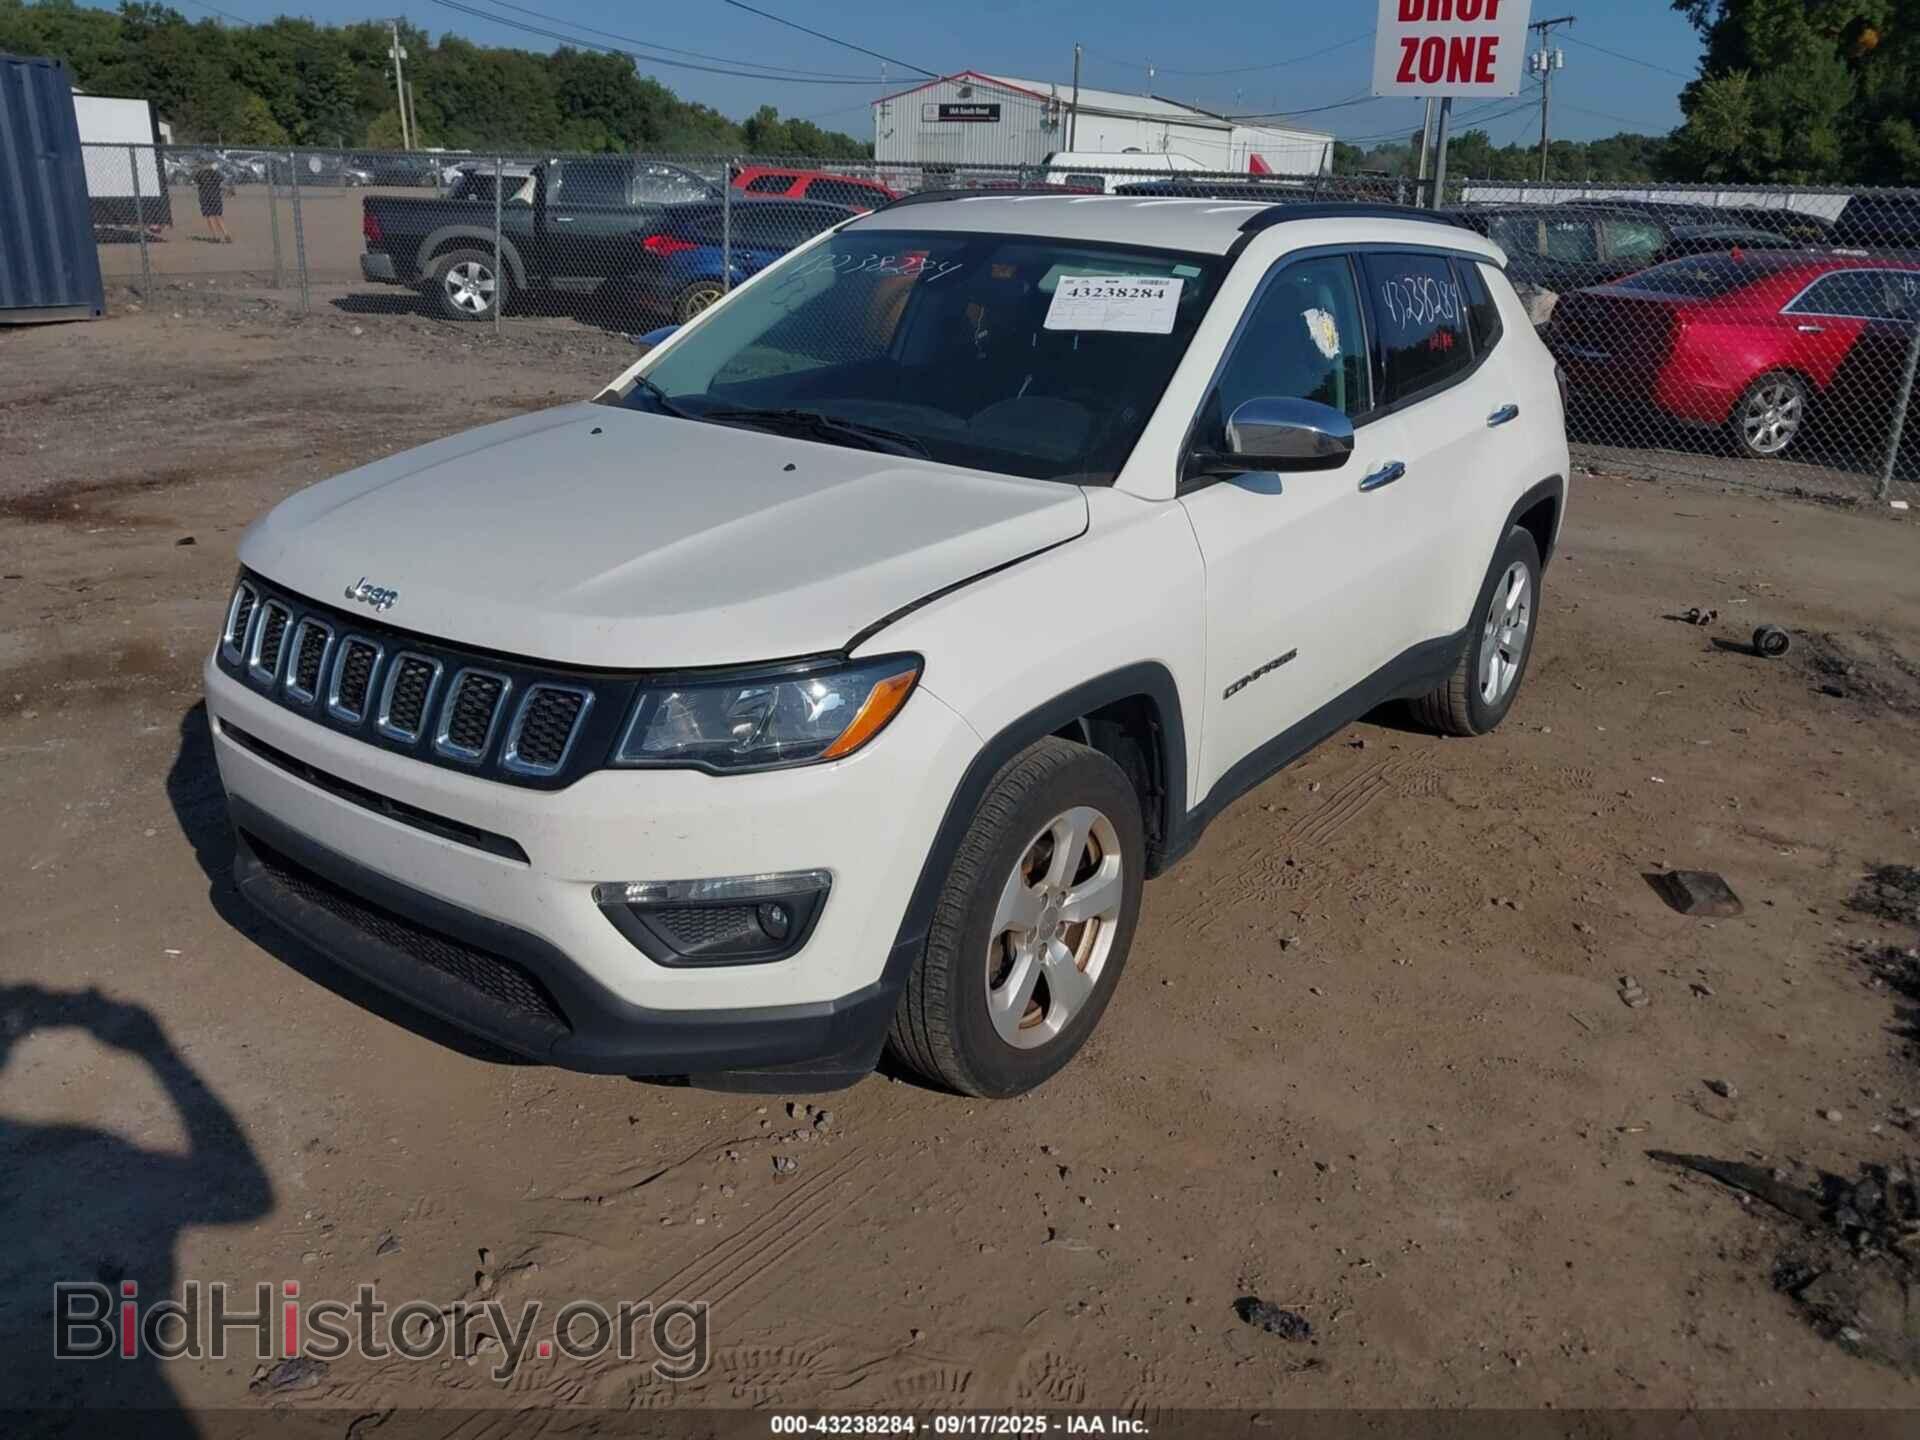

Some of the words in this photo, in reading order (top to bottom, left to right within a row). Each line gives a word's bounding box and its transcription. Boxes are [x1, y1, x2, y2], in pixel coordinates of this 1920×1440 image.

[1397, 36, 1499, 83] ZONE
[1067, 287, 1165, 299] 43238284
[1381, 276, 1461, 331] 43238284
[345, 576, 398, 613] Jeep
[1222, 648, 1298, 701] COMPASS
